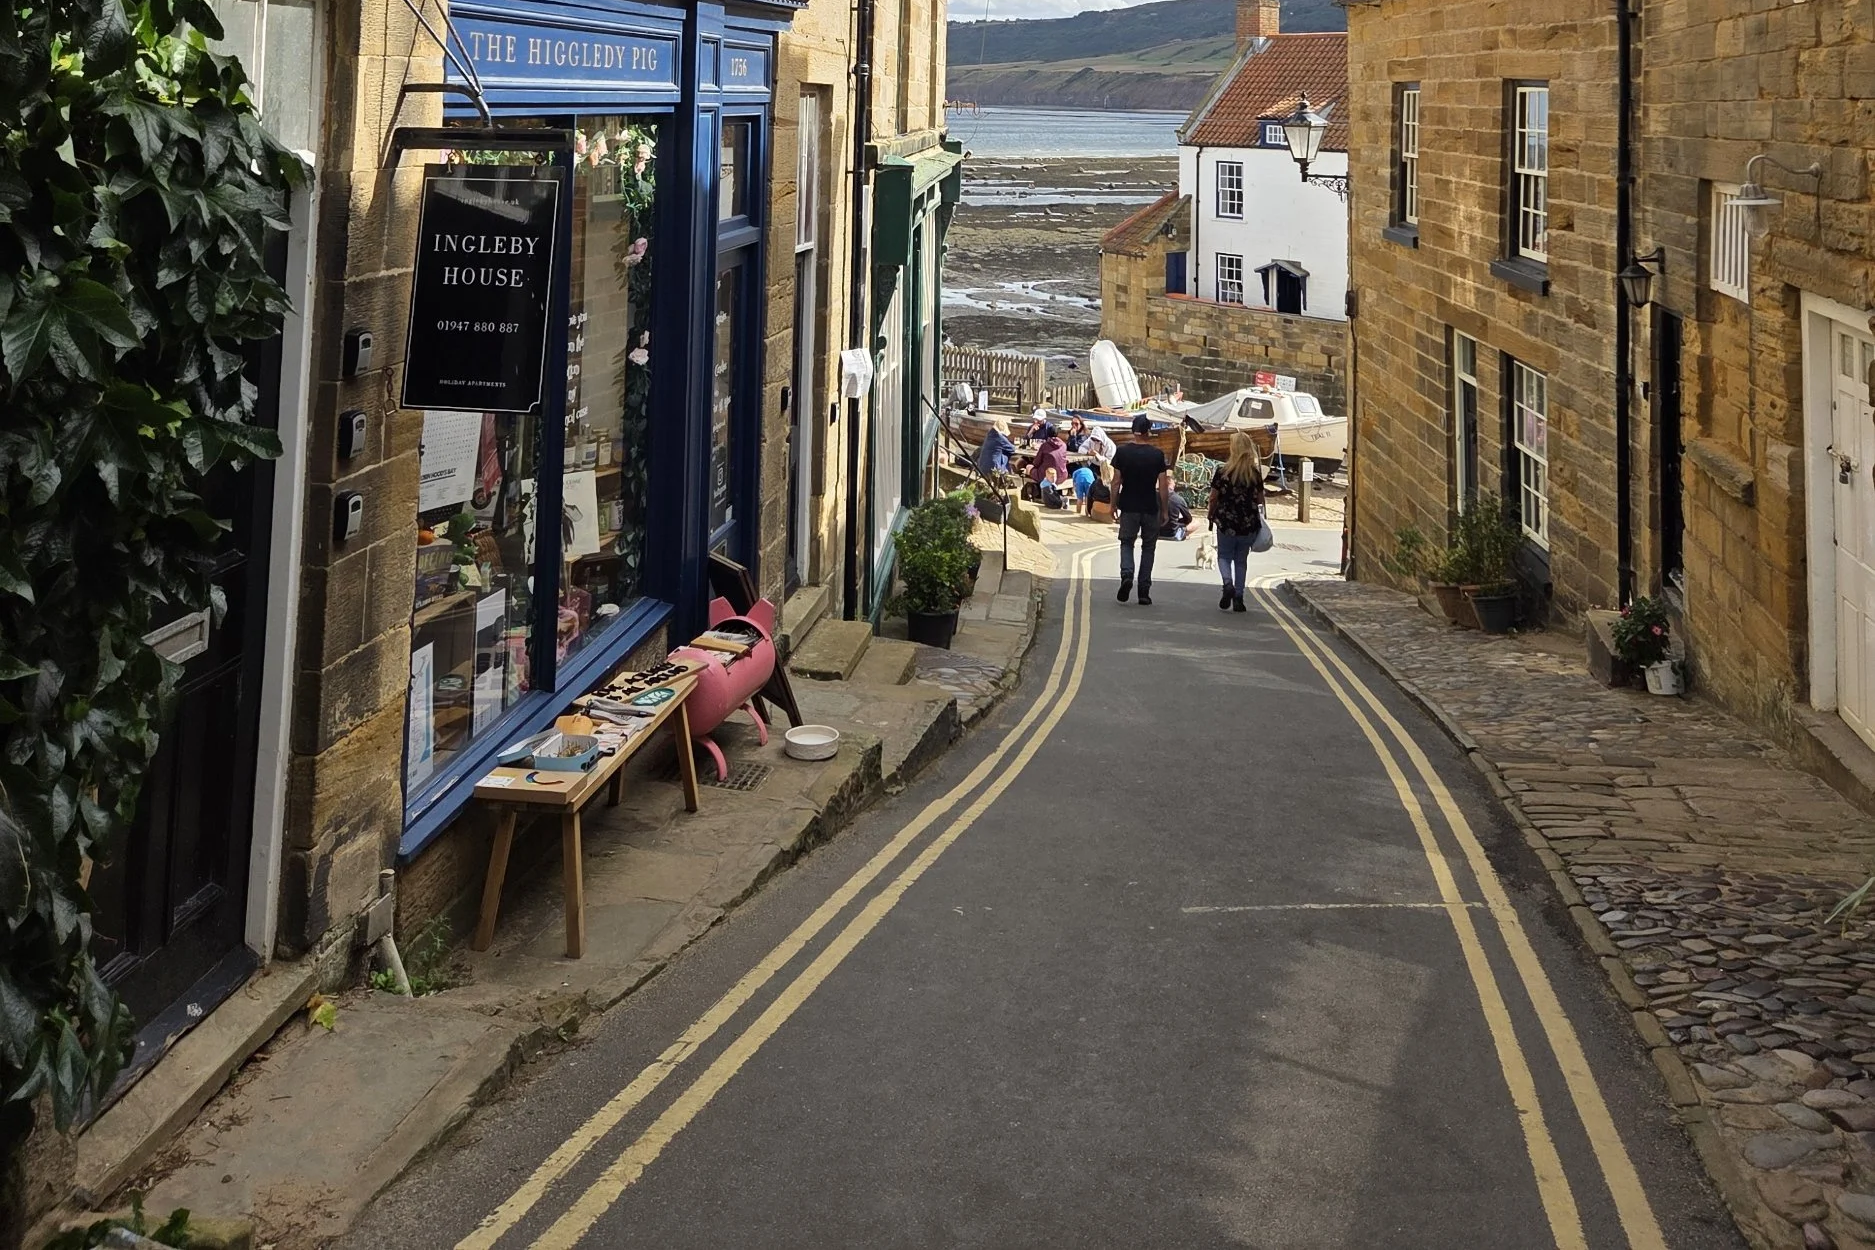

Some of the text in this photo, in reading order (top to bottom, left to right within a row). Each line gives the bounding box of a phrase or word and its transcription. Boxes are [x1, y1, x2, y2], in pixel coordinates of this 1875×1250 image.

[470, 31, 658, 71] THE HIGGLEDY PIG
[731, 57, 747, 77] 1756
[433, 233, 540, 255] INGLEBY
[442, 266, 524, 288] HOUSE
[437, 320, 520, 333] 01947 880 887
[467, 380, 506, 388] APARTMENTS
